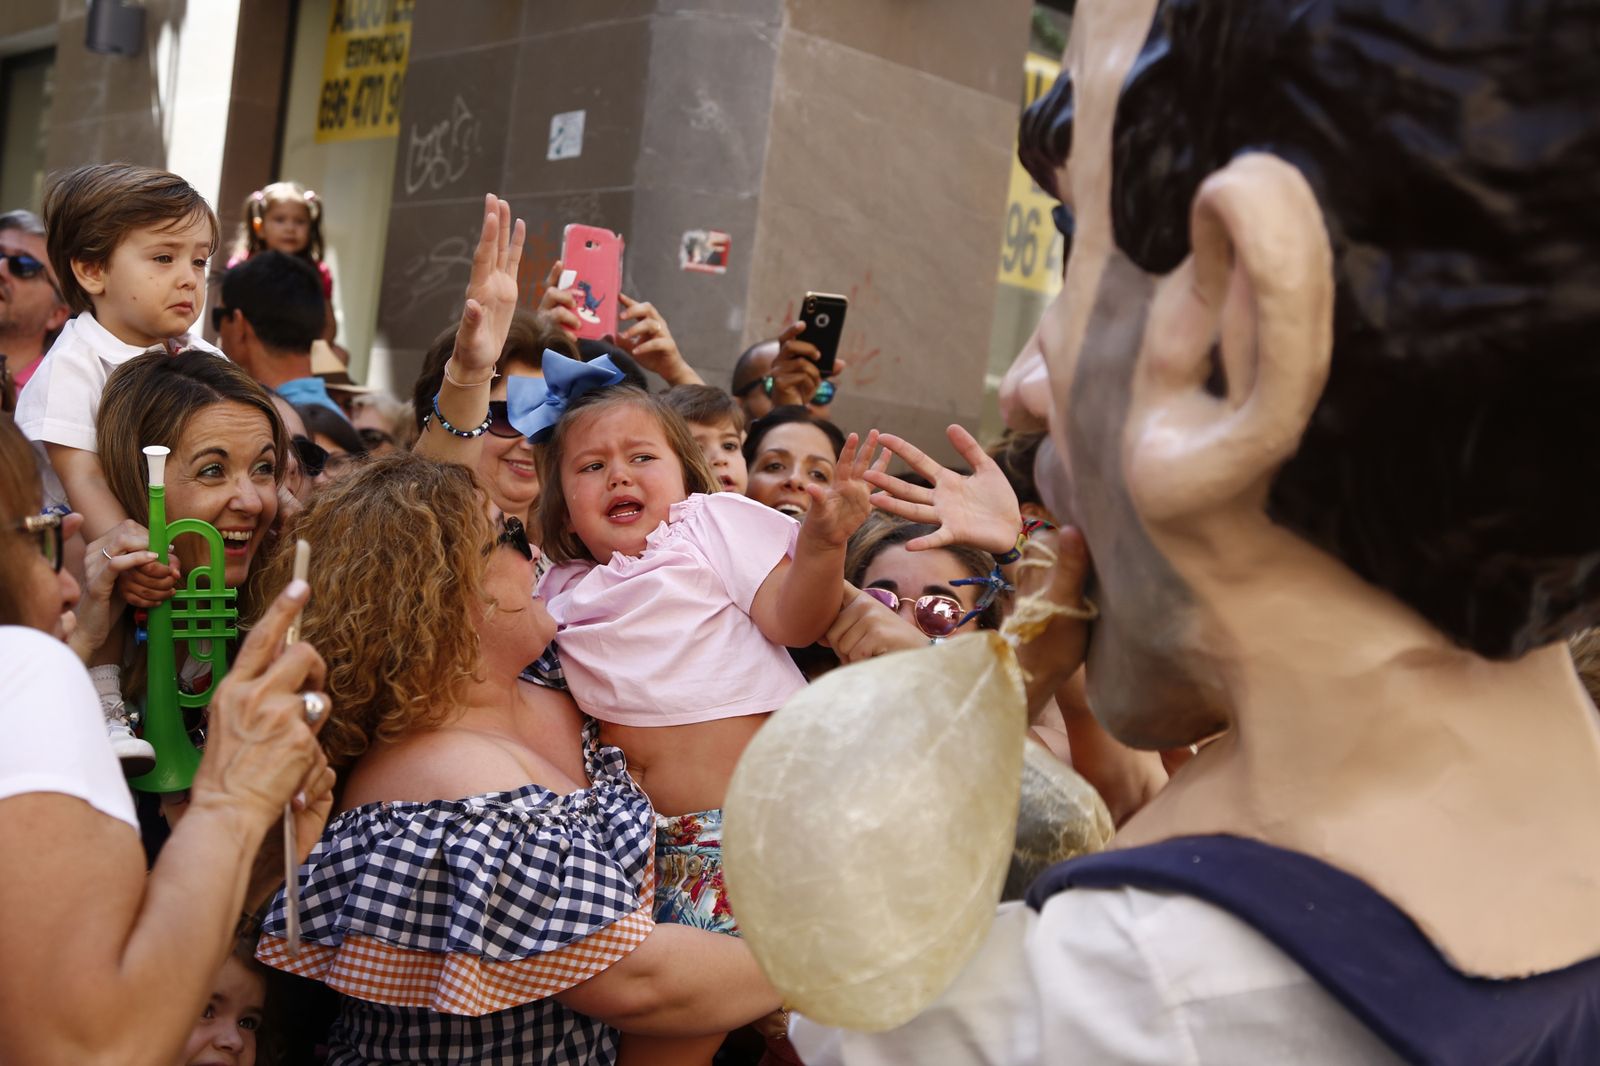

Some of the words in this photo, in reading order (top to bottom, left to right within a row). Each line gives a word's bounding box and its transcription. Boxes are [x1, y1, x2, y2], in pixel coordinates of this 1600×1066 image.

[346, 32, 405, 69] EDIFICIO
[318, 77, 352, 131] 696
[352, 74, 386, 127] 470
